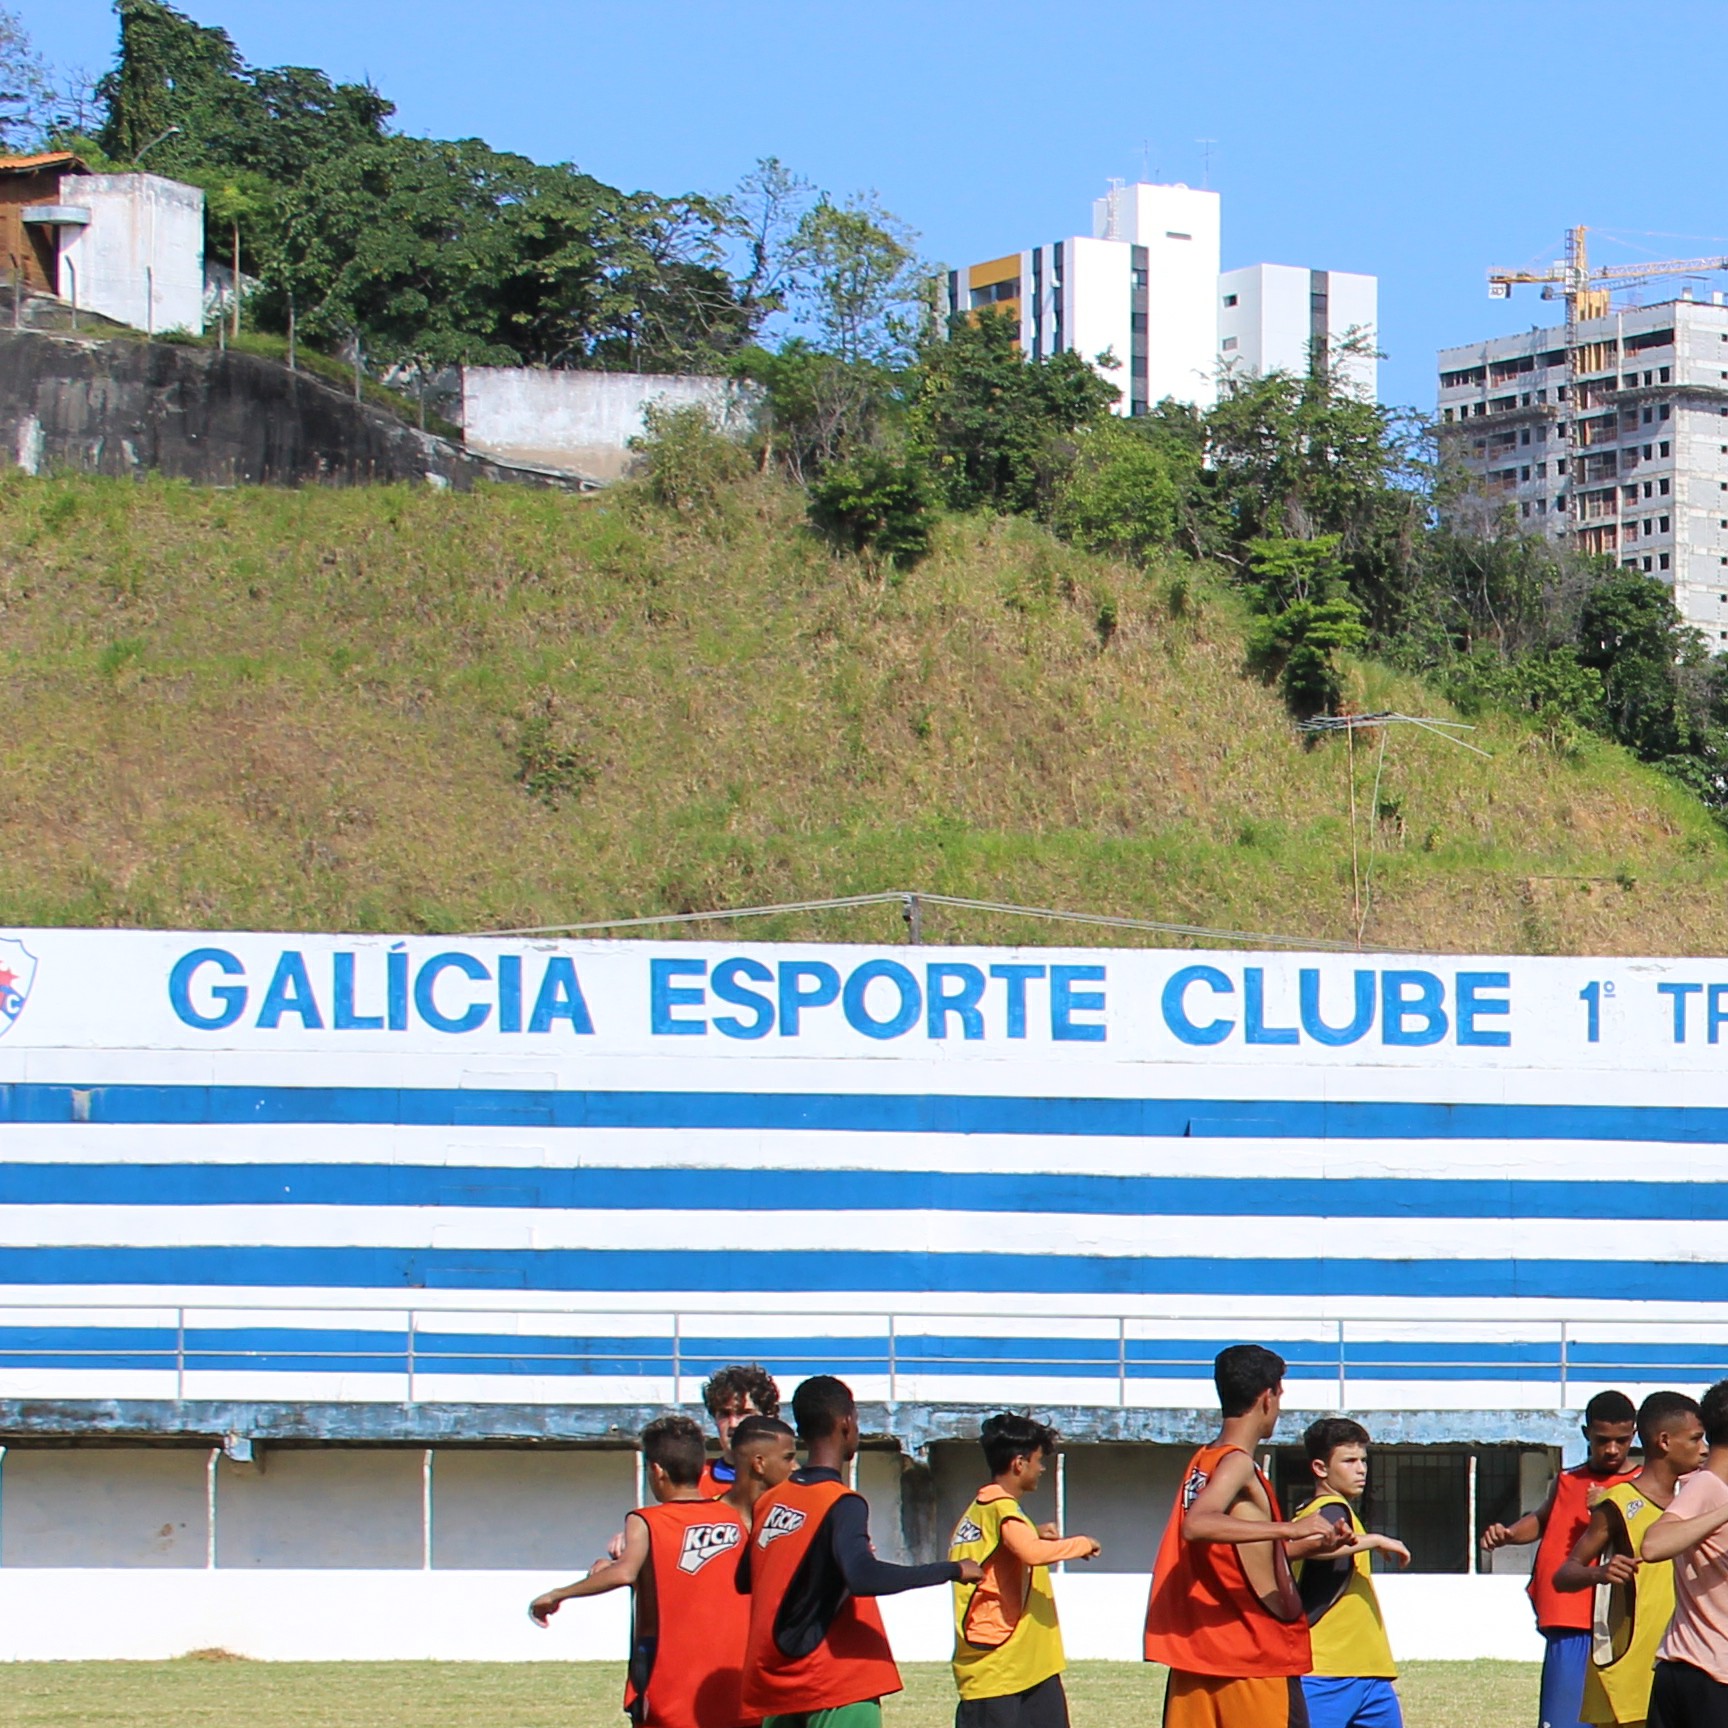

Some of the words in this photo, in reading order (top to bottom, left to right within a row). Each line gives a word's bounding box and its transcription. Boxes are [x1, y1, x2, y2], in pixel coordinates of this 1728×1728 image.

[169, 941, 595, 1036] GALÍCIA
[650, 957, 1108, 1044] ESPORTE
[1161, 965, 1512, 1049] CLUBE
